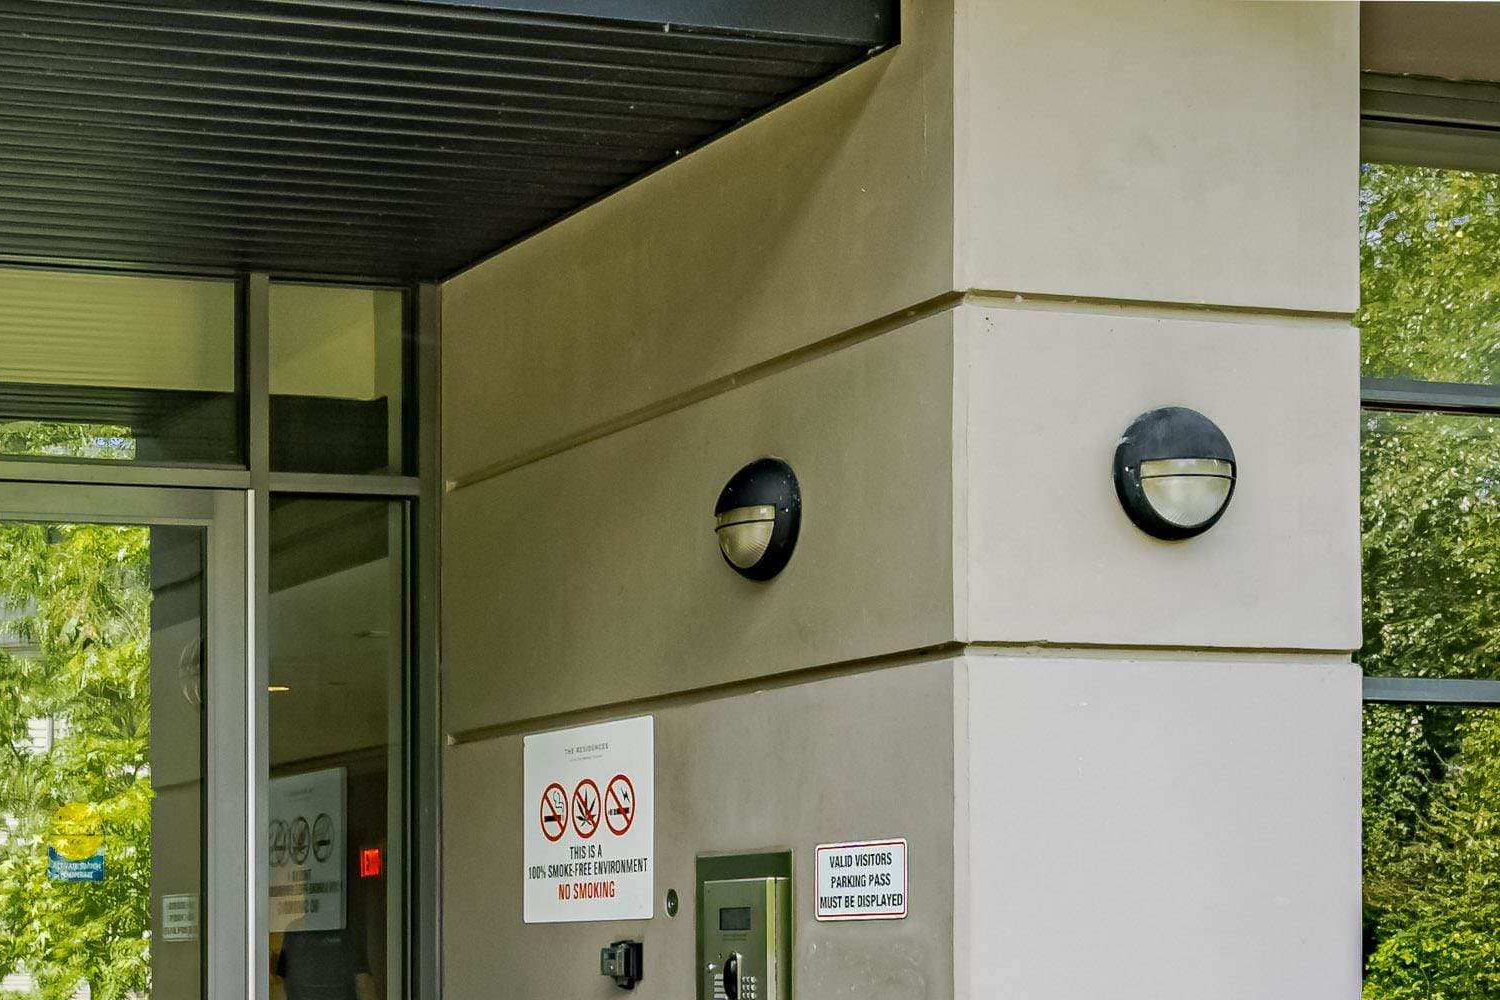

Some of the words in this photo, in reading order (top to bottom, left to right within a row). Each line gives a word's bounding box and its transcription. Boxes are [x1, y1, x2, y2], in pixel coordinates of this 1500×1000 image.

[570, 845, 587, 860] THIS
[588, 845, 596, 859] IS
[597, 844, 603, 858] A
[829, 855, 853, 868] VALID
[855, 852, 892, 867] VISITORS
[528, 865, 547, 879] 100%
[548, 862, 592, 878] SMOKE-FREE
[593, 858, 648, 876] ENVIRONMENT
[831, 874, 867, 888] PARKING
[868, 873, 891, 887] PASS
[558, 883, 571, 900] NO
[573, 880, 615, 900] SMOKING
[820, 896, 842, 909] MUST
[844, 895, 855, 908] BE
[857, 893, 903, 907] DISPLAYED
